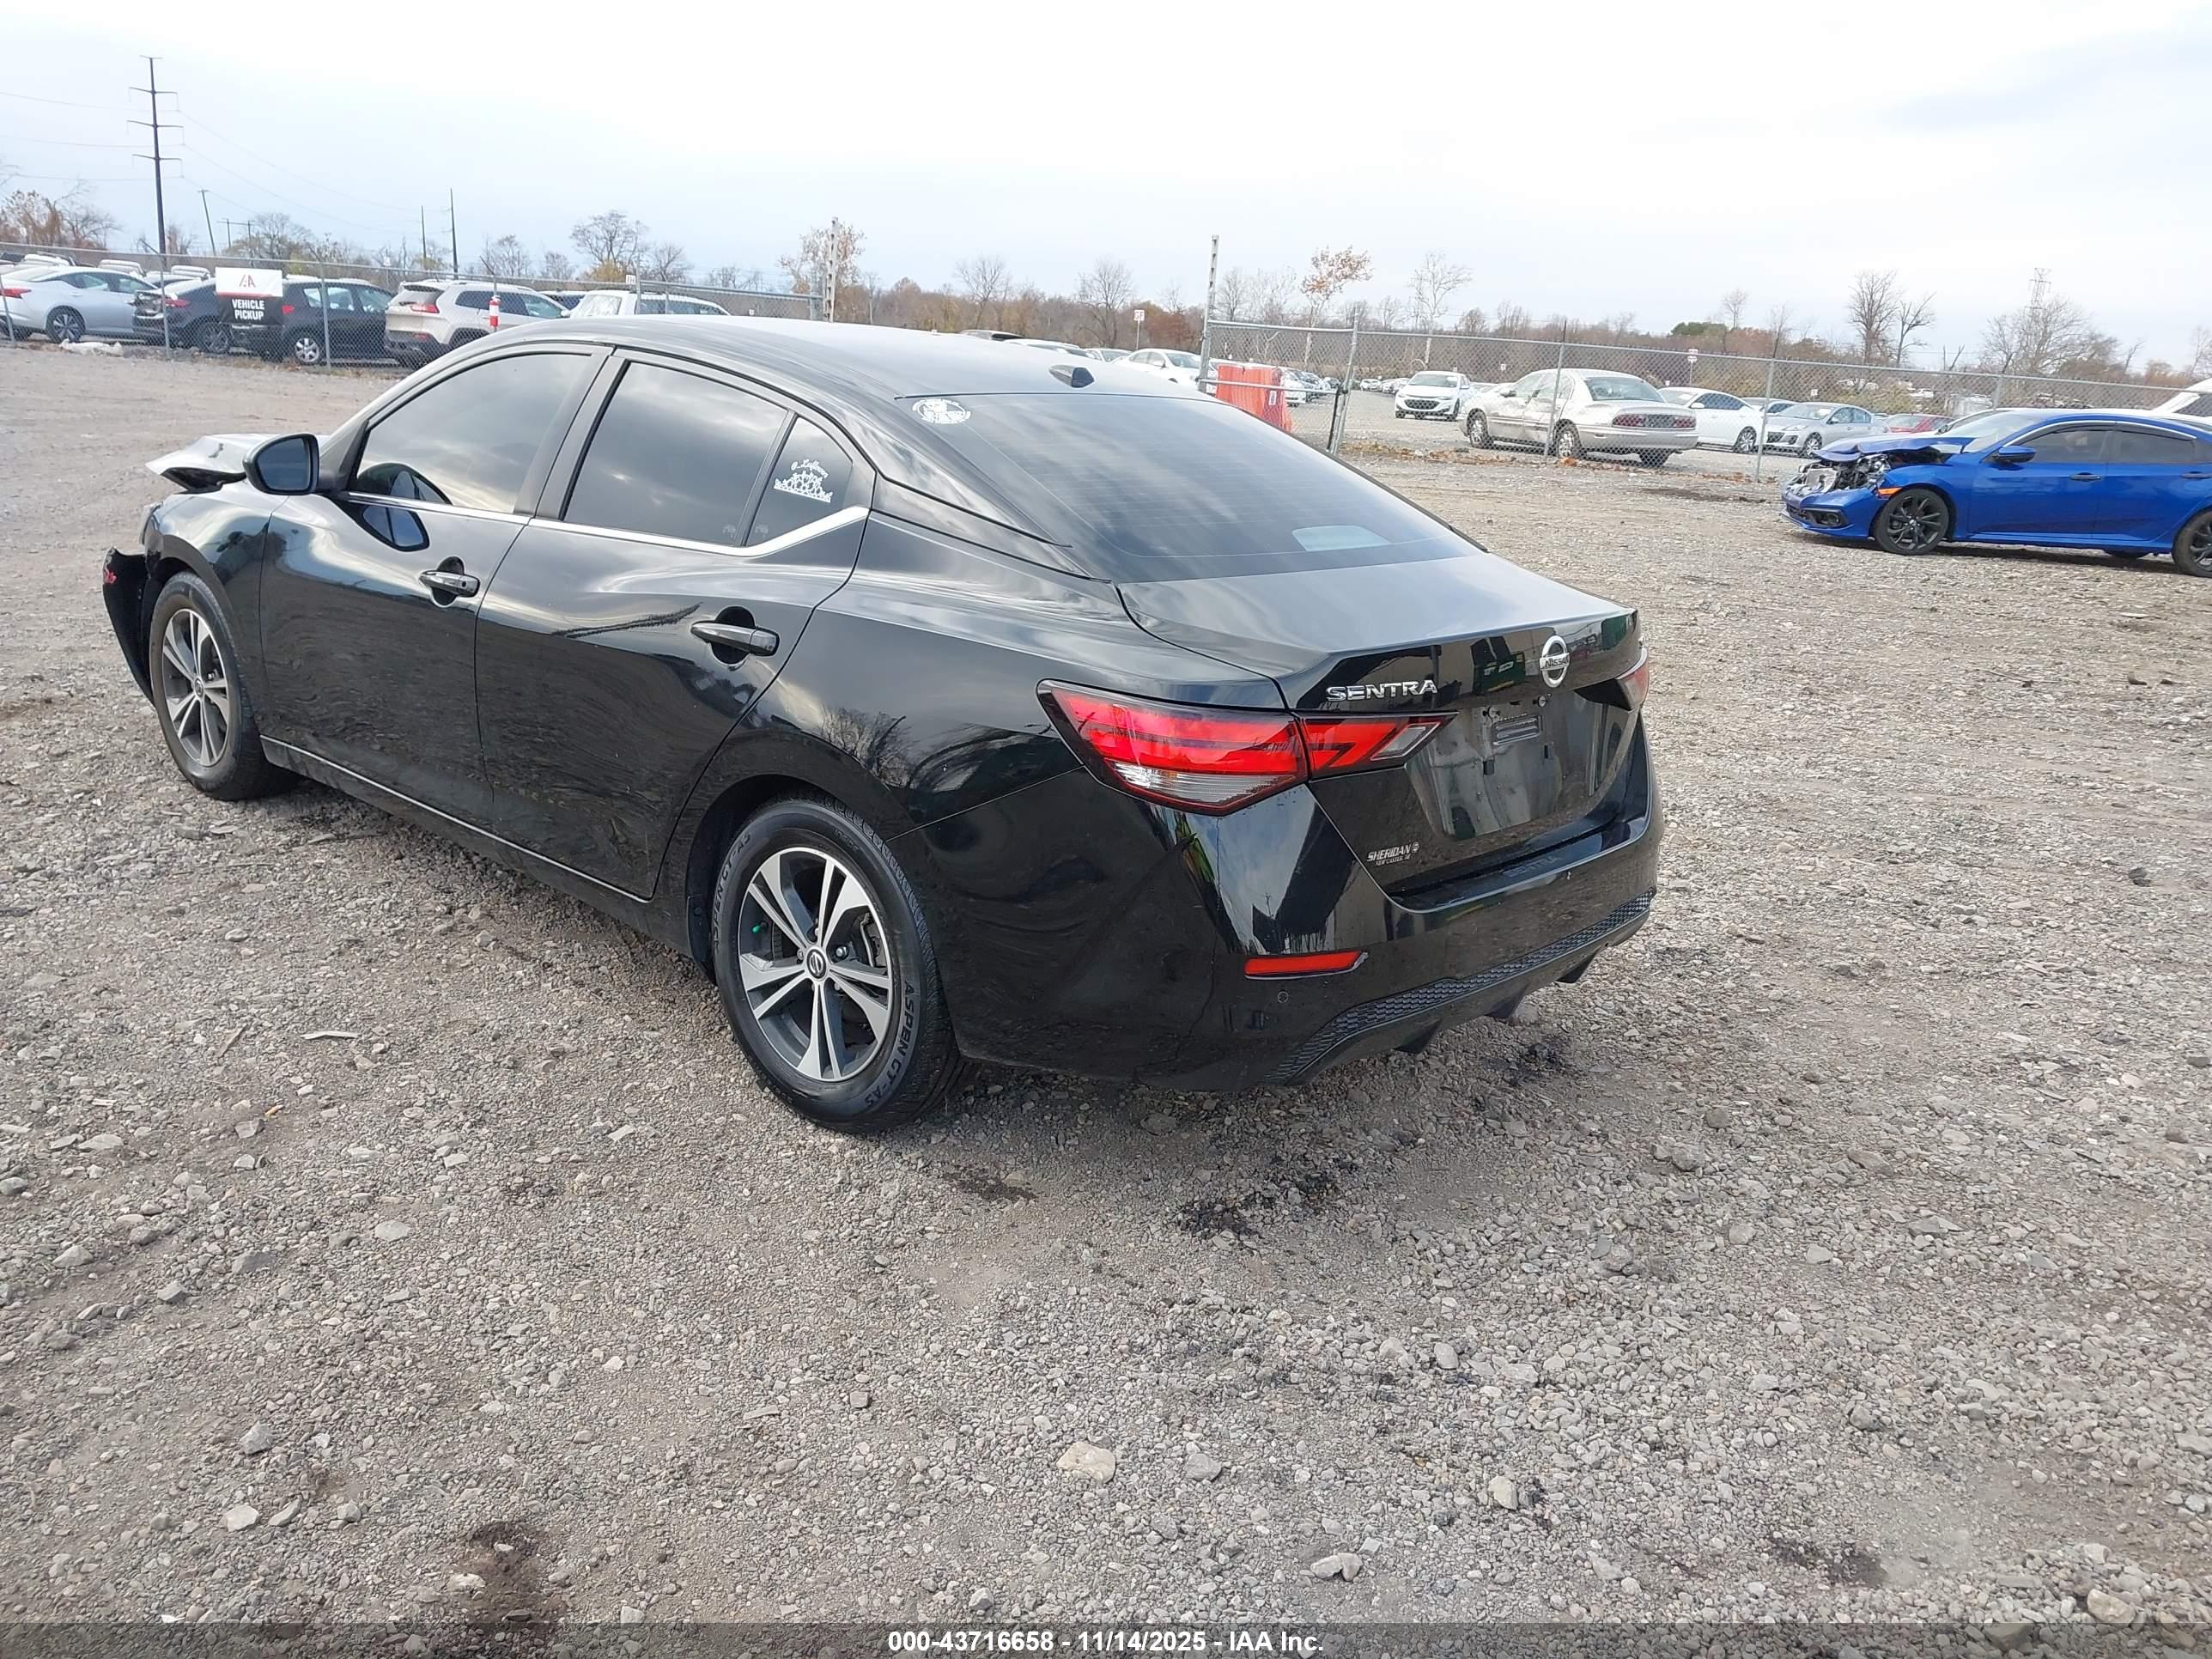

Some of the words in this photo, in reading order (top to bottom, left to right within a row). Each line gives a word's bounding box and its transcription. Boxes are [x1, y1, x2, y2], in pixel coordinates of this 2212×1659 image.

[232, 299, 265, 310] VEHICLE
[234, 309, 264, 320] PICKUP
[1326, 679, 1437, 702] SENTRA
[1367, 844, 1412, 862] SHERIDAN
[896, 981, 915, 1058] ASPEN
